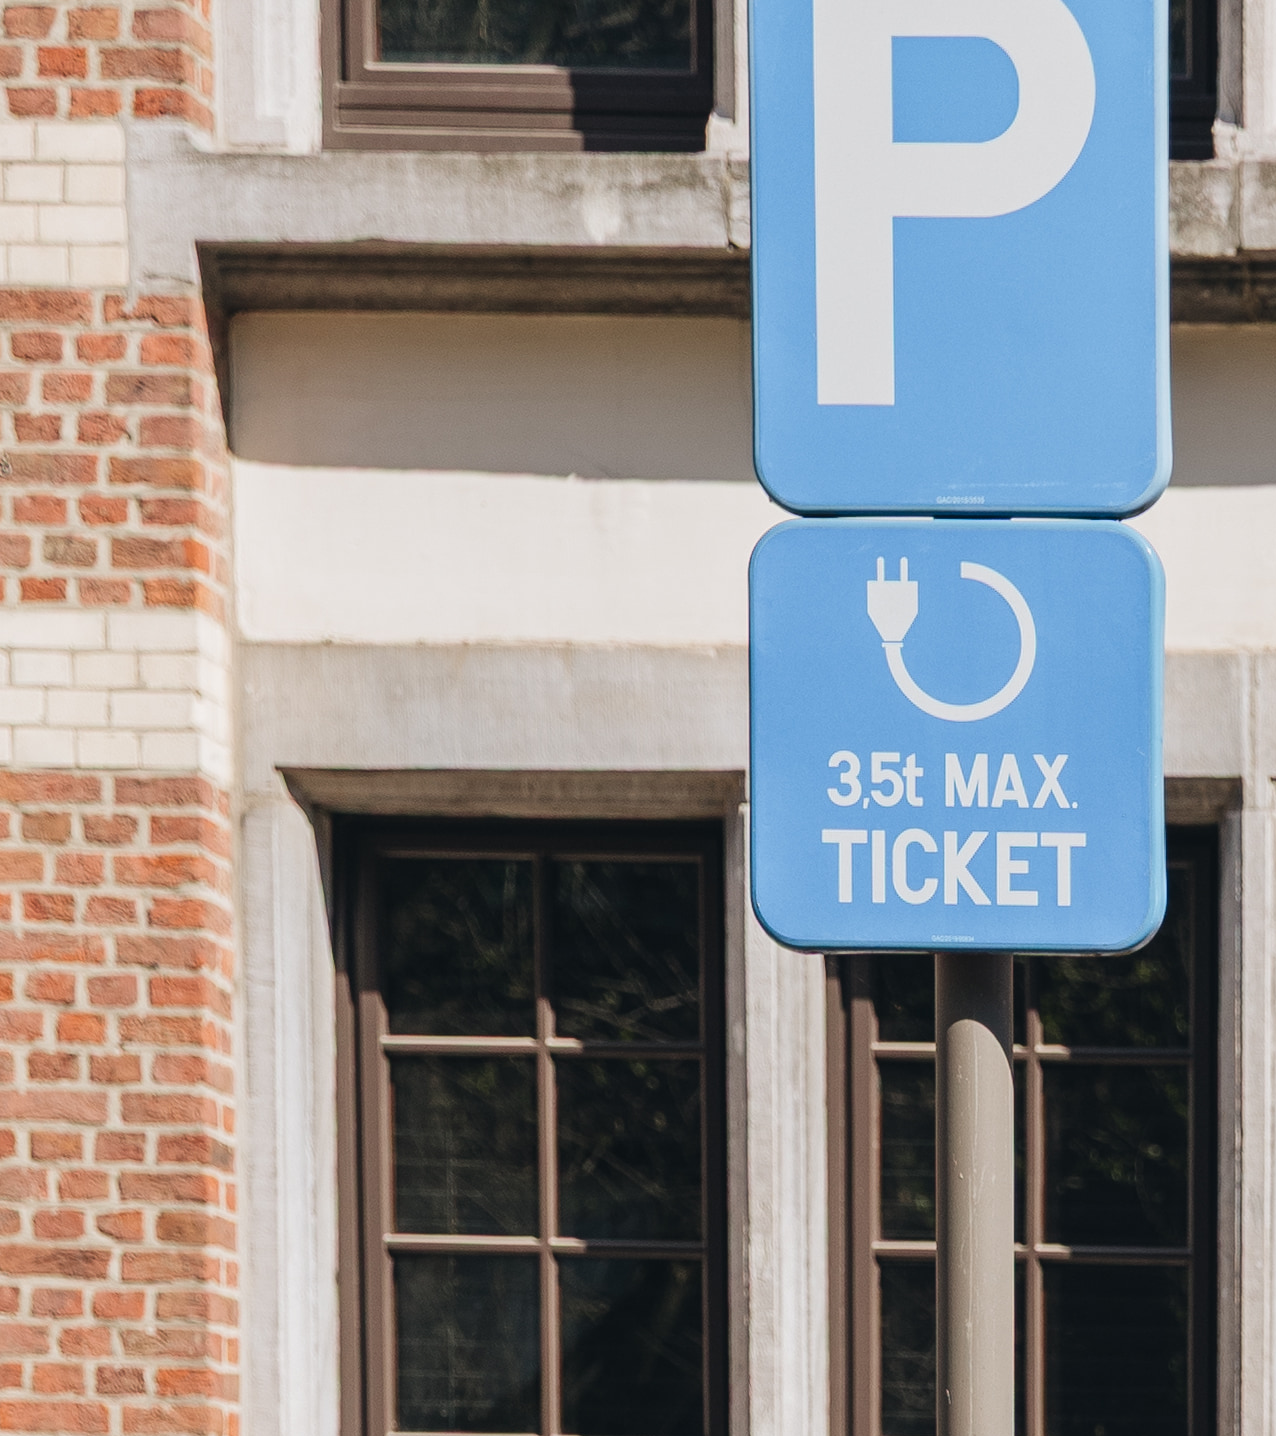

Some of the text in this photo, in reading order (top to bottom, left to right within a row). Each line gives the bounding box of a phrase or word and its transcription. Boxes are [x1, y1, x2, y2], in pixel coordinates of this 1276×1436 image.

[813, 0, 1096, 406] P
[827, 750, 1079, 809] 3,5t MAX.
[821, 828, 1087, 907] TICKET
